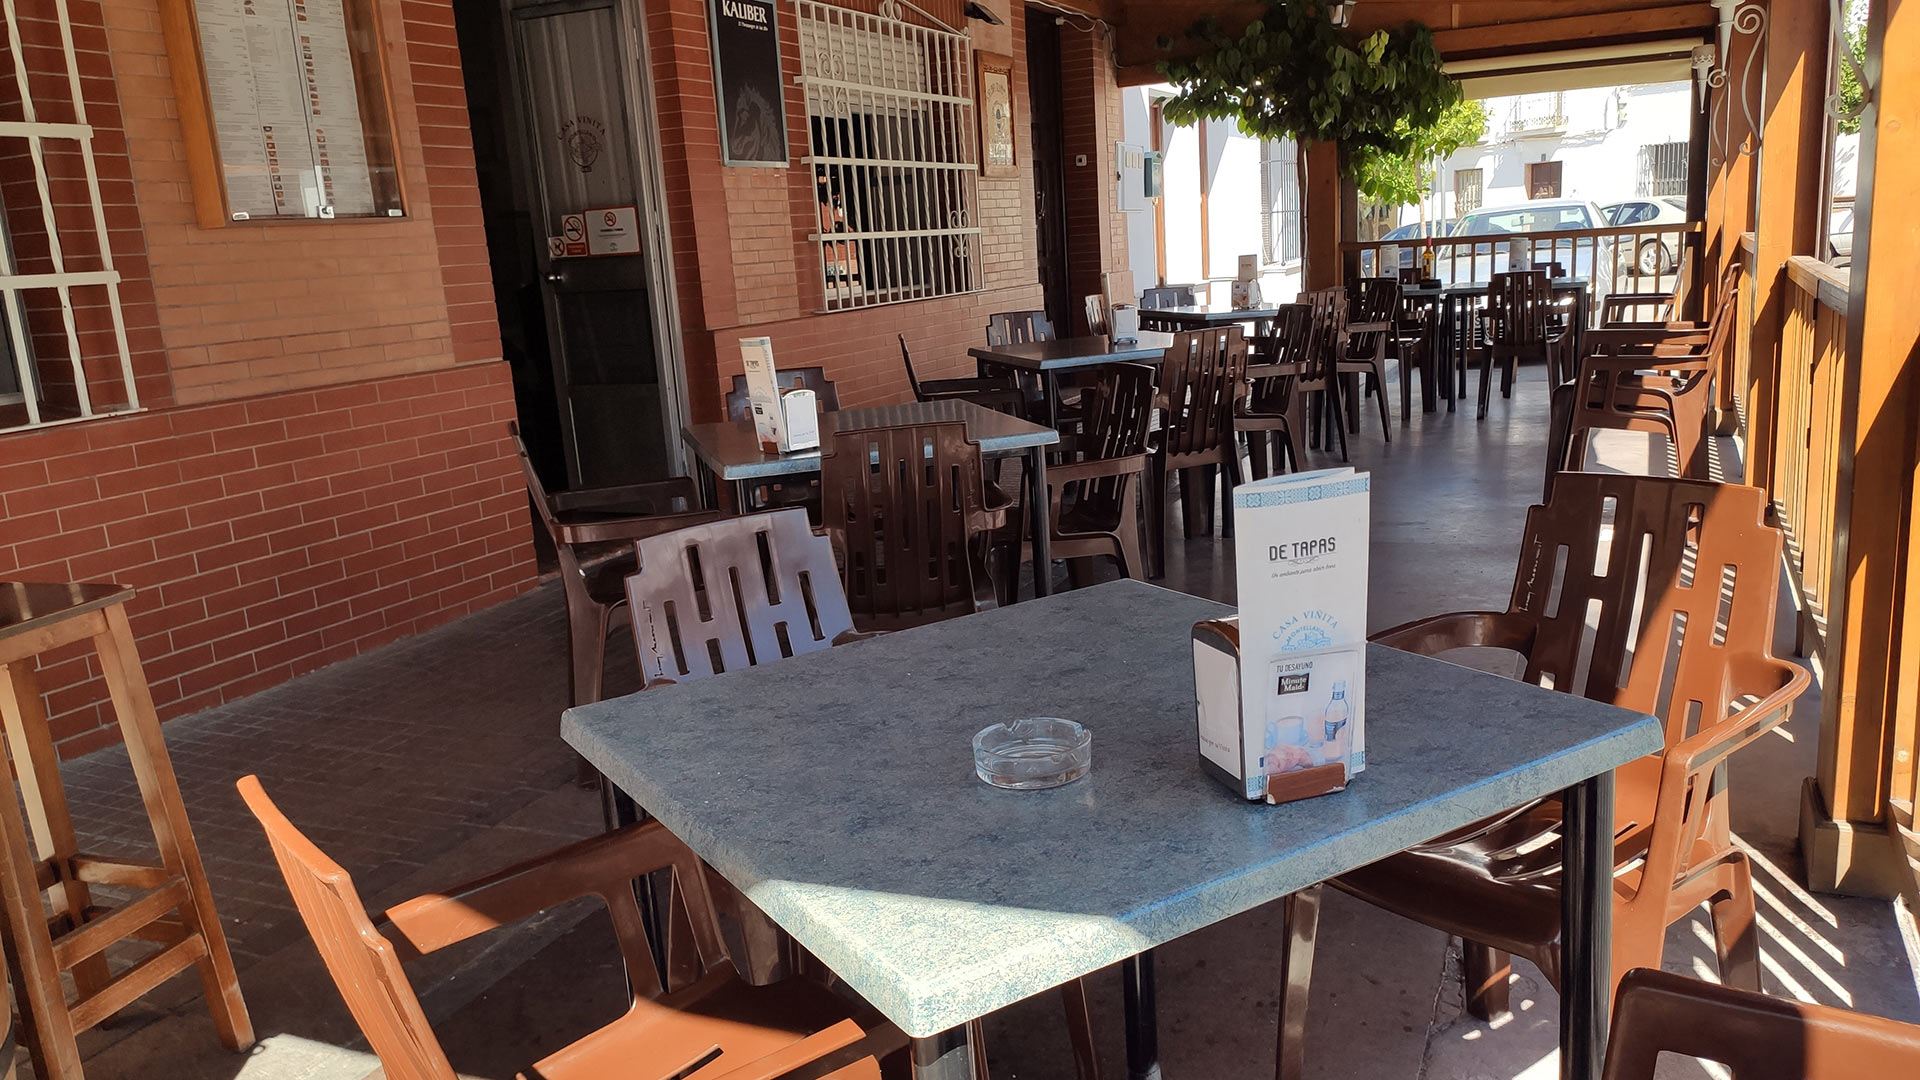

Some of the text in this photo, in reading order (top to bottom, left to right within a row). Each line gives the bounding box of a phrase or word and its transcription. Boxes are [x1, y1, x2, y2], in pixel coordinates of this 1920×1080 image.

[722, 0, 768, 24] KALIBER
[1269, 536, 1336, 561] DE TAPAS
[1272, 615, 1299, 640] CASA
[1277, 661, 1314, 673] TU DESAYUNO
[1281, 677, 1308, 686] Minute
[1284, 683, 1303, 692] Maid
